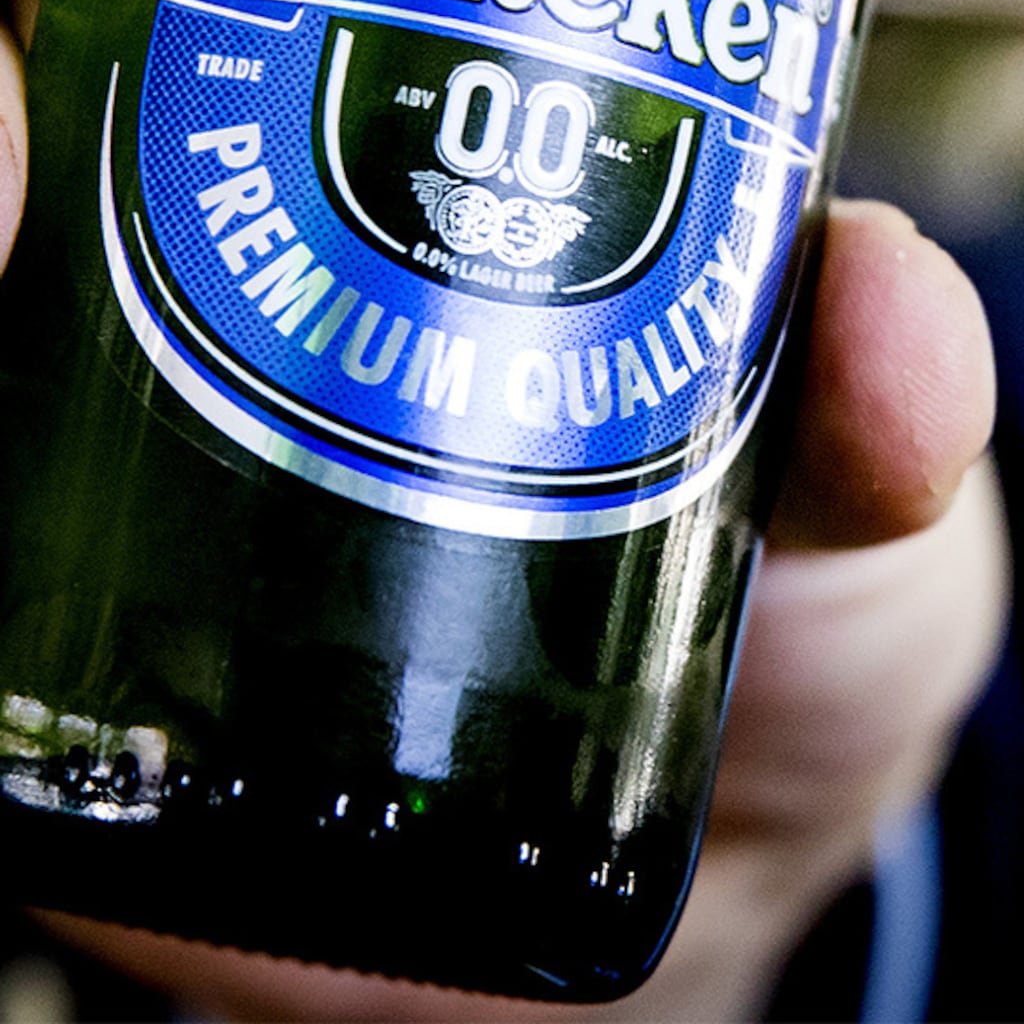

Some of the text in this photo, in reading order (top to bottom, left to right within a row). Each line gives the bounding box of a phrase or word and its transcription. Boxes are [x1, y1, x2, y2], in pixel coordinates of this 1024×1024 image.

[197, 53, 264, 81] TRADE
[393, 85, 437, 110] ABV
[434, 59, 597, 198] 0.0
[187, 122, 748, 432] PREMIUM QUALITY
[412, 241, 458, 276] 0.0%
